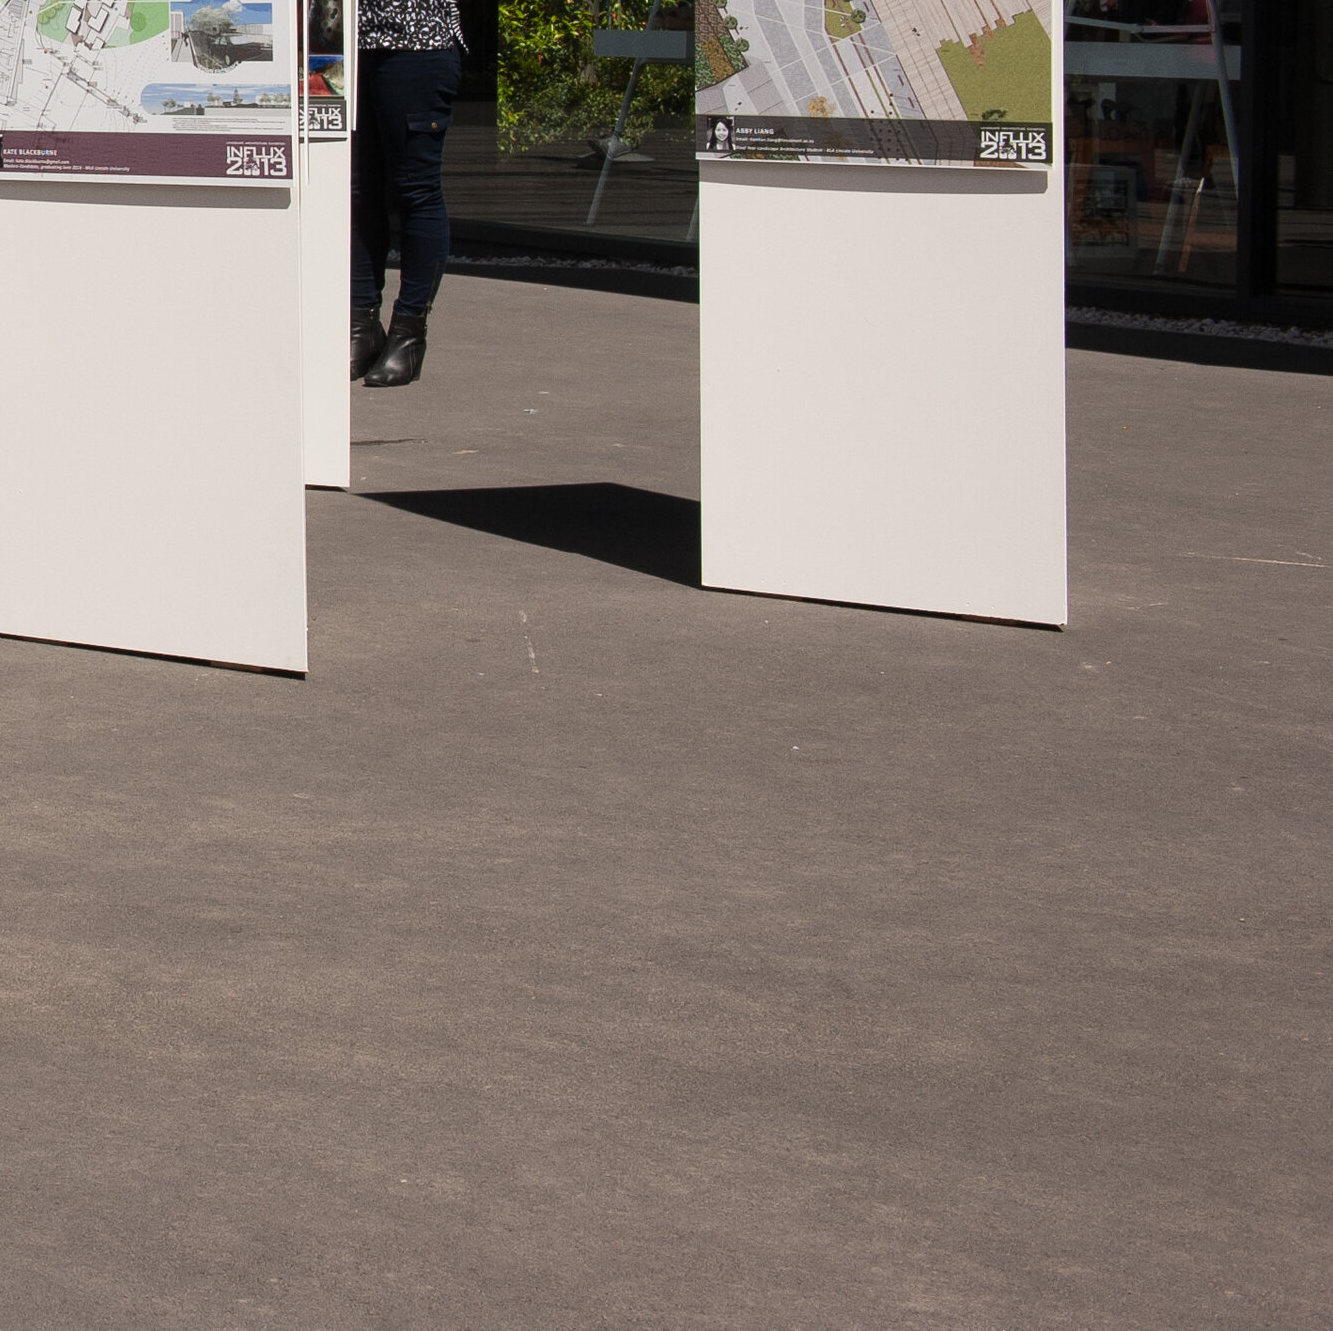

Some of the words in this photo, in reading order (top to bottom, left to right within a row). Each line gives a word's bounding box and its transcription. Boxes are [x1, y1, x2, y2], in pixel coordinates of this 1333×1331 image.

[980, 131, 1046, 144] INFLUX
[226, 146, 285, 158] INFLUX
[980, 141, 1047, 160] 2013
[225, 157, 287, 176] 2013
